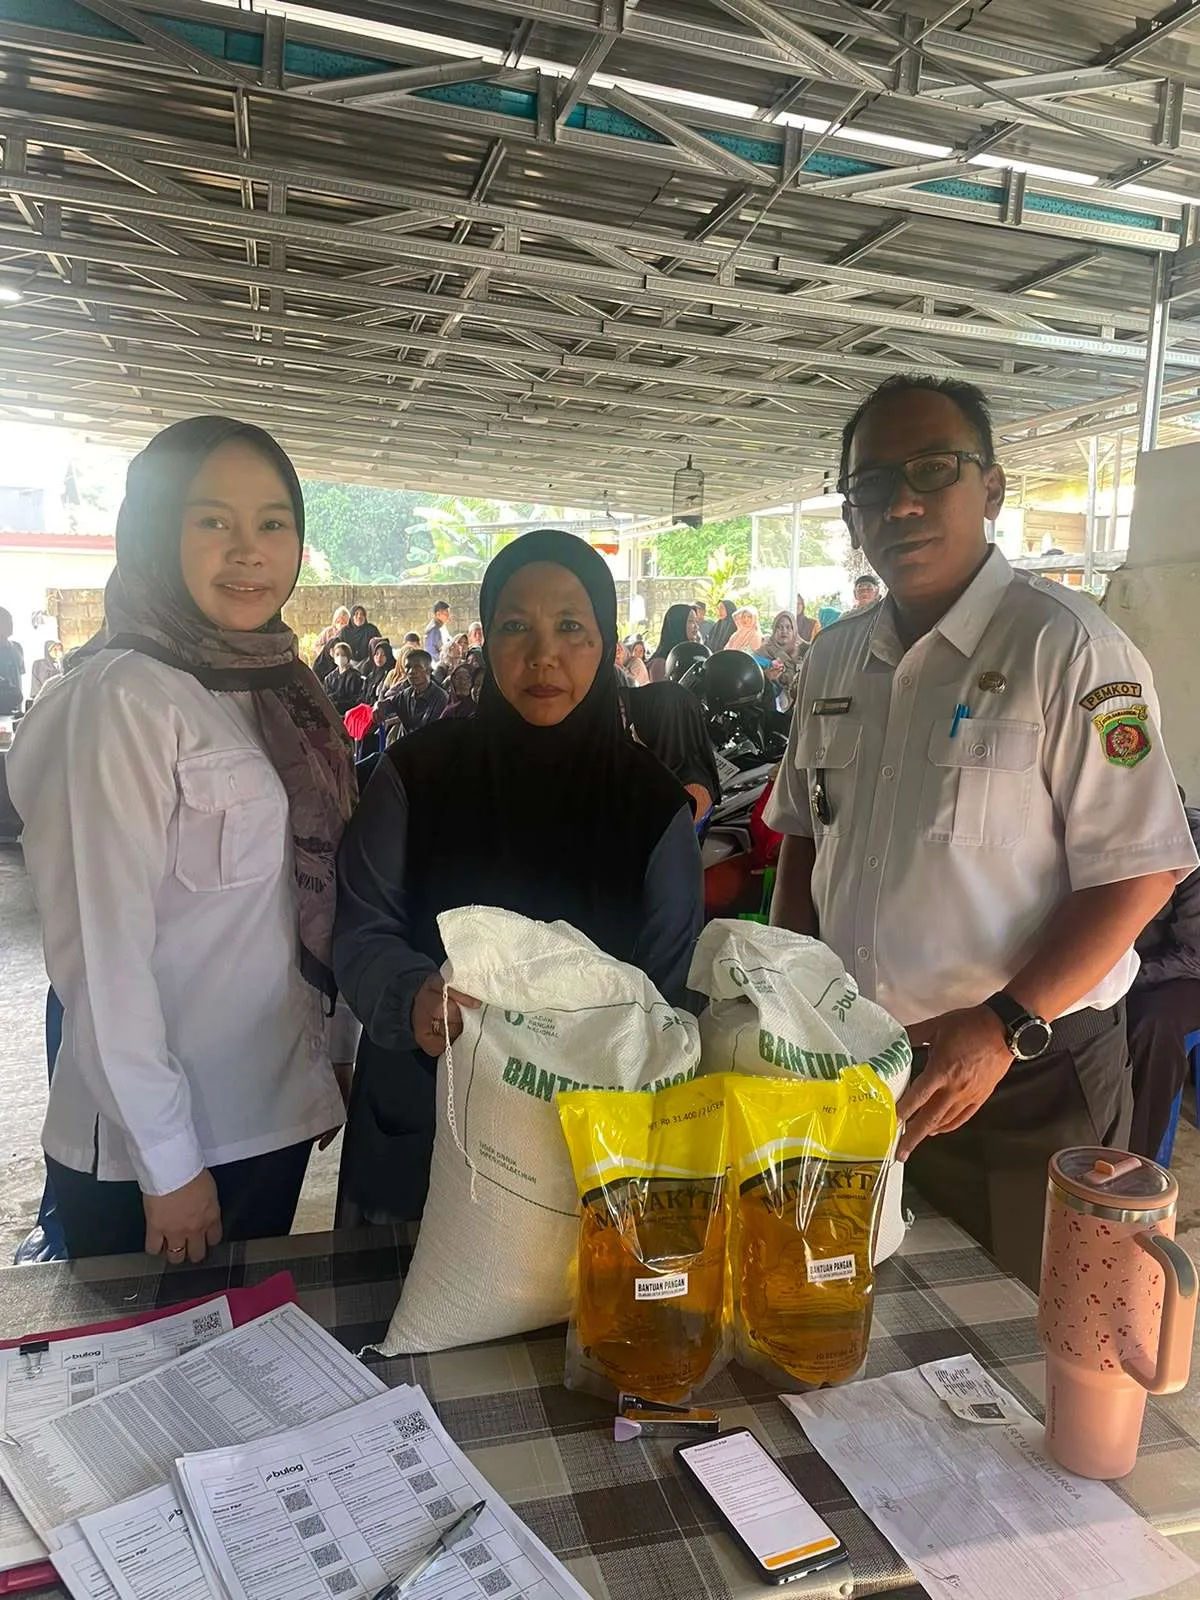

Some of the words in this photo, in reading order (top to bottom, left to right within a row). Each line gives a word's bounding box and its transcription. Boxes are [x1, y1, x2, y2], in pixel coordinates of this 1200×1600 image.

[1087, 685, 1138, 706] PEMKOT
[759, 1029, 858, 1080] BANTUA
[822, 1105, 837, 1115] HET
[810, 1263, 833, 1274] BANTUAN
[833, 1260, 853, 1271] PANGAN
[638, 1282, 663, 1292] BANTUAN
[664, 1278, 685, 1290] PANGAN
[71, 1350, 101, 1360] bulog
[272, 1463, 304, 1478] bulog
[1028, 1449, 1084, 1501] KELUARGA
